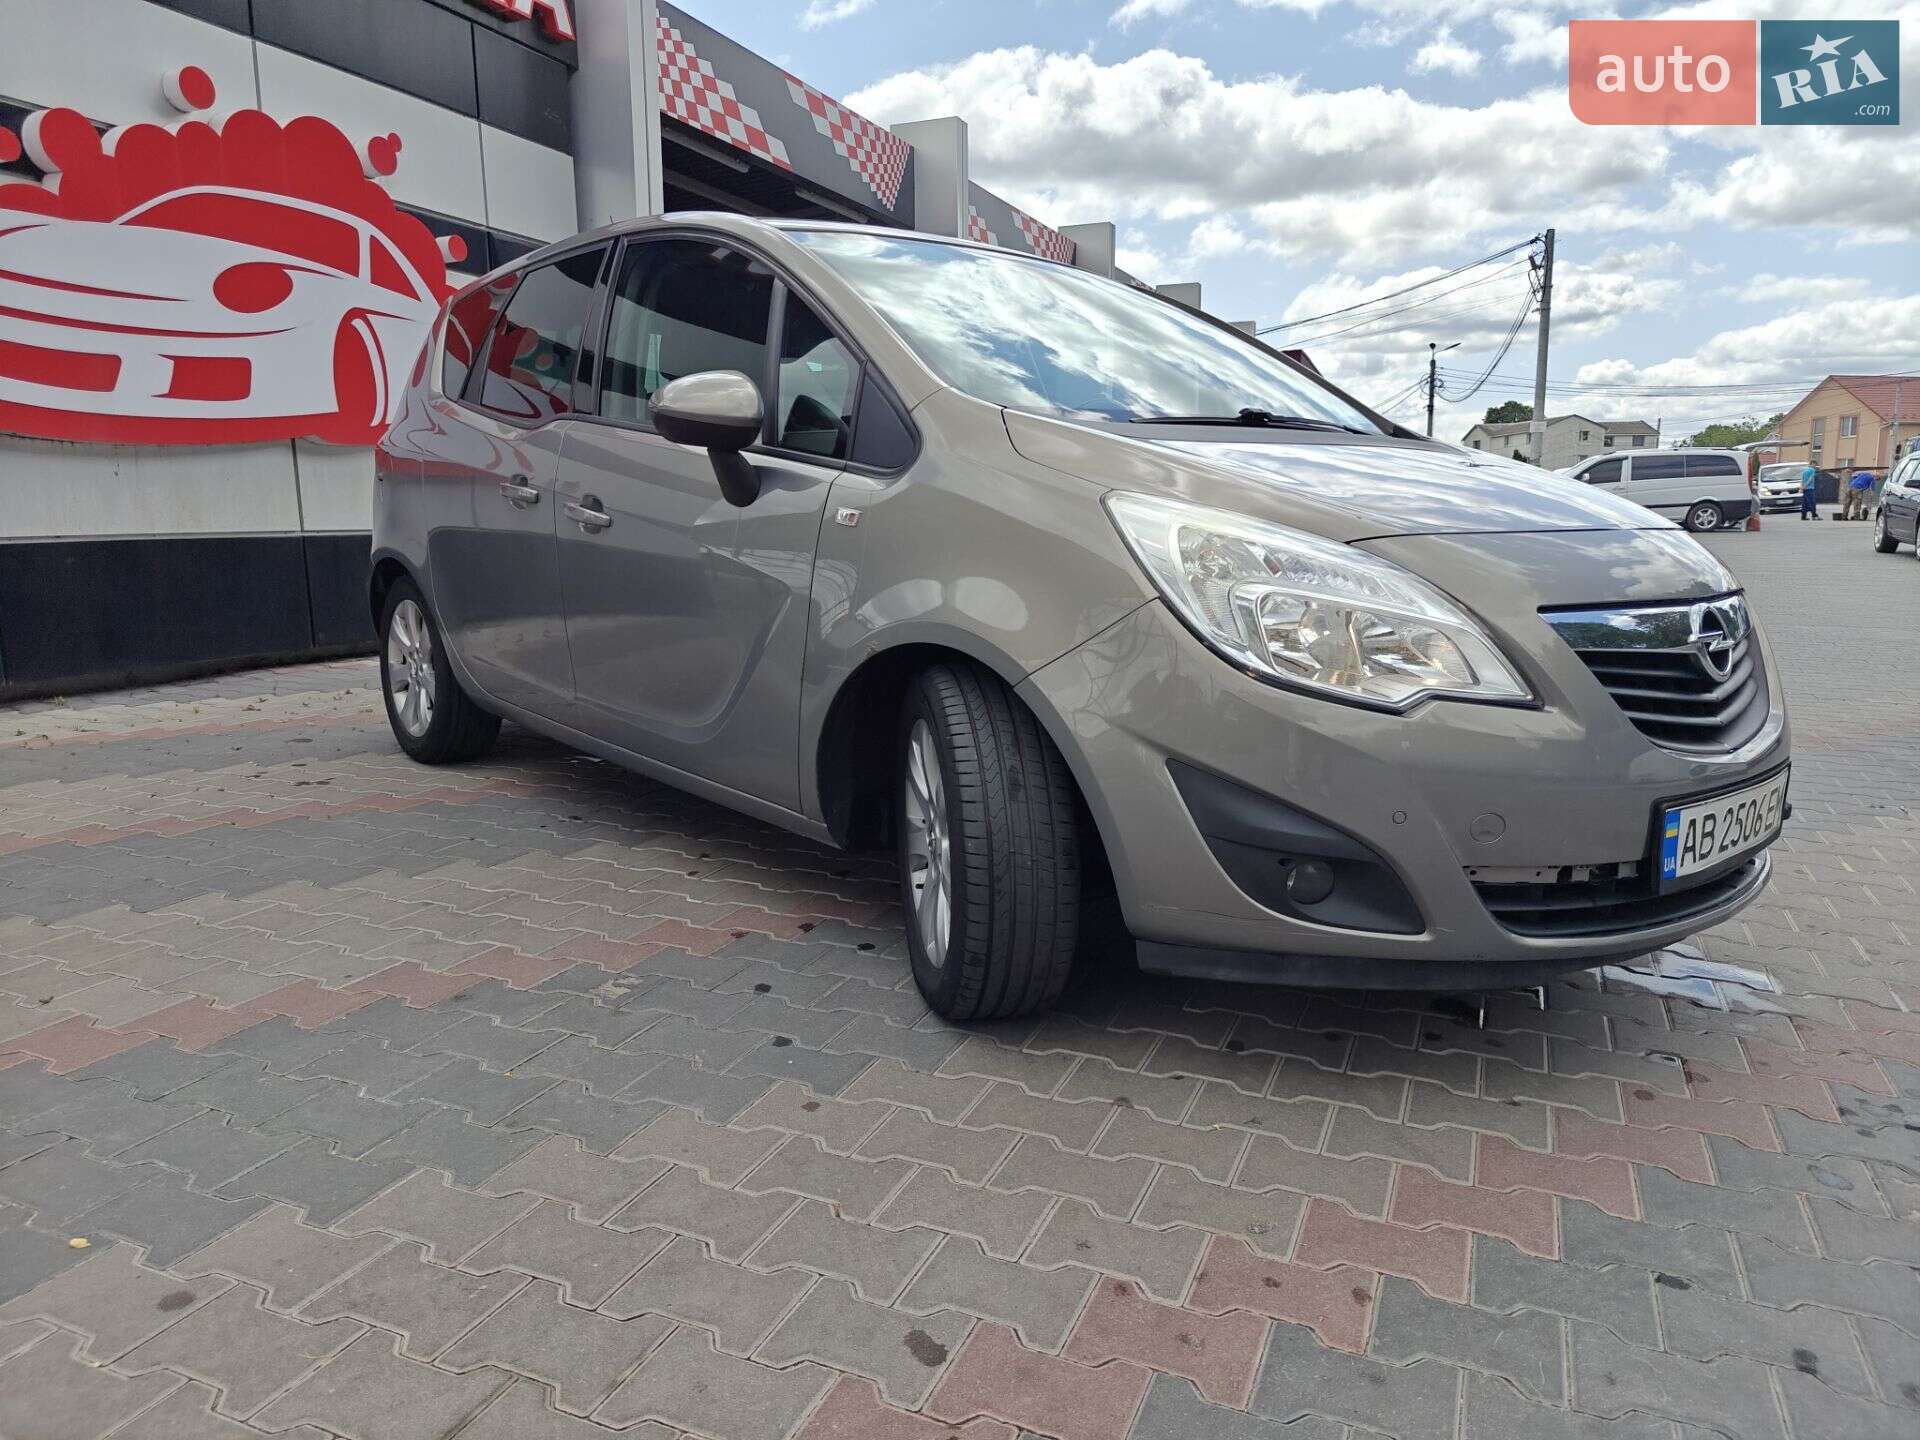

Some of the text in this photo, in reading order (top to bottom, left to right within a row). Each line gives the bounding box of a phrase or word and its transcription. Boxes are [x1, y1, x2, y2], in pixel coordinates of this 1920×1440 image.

[1680, 812, 1717, 868] AB
[1718, 793, 1767, 854] 2506
[1664, 856, 1676, 873] UA
